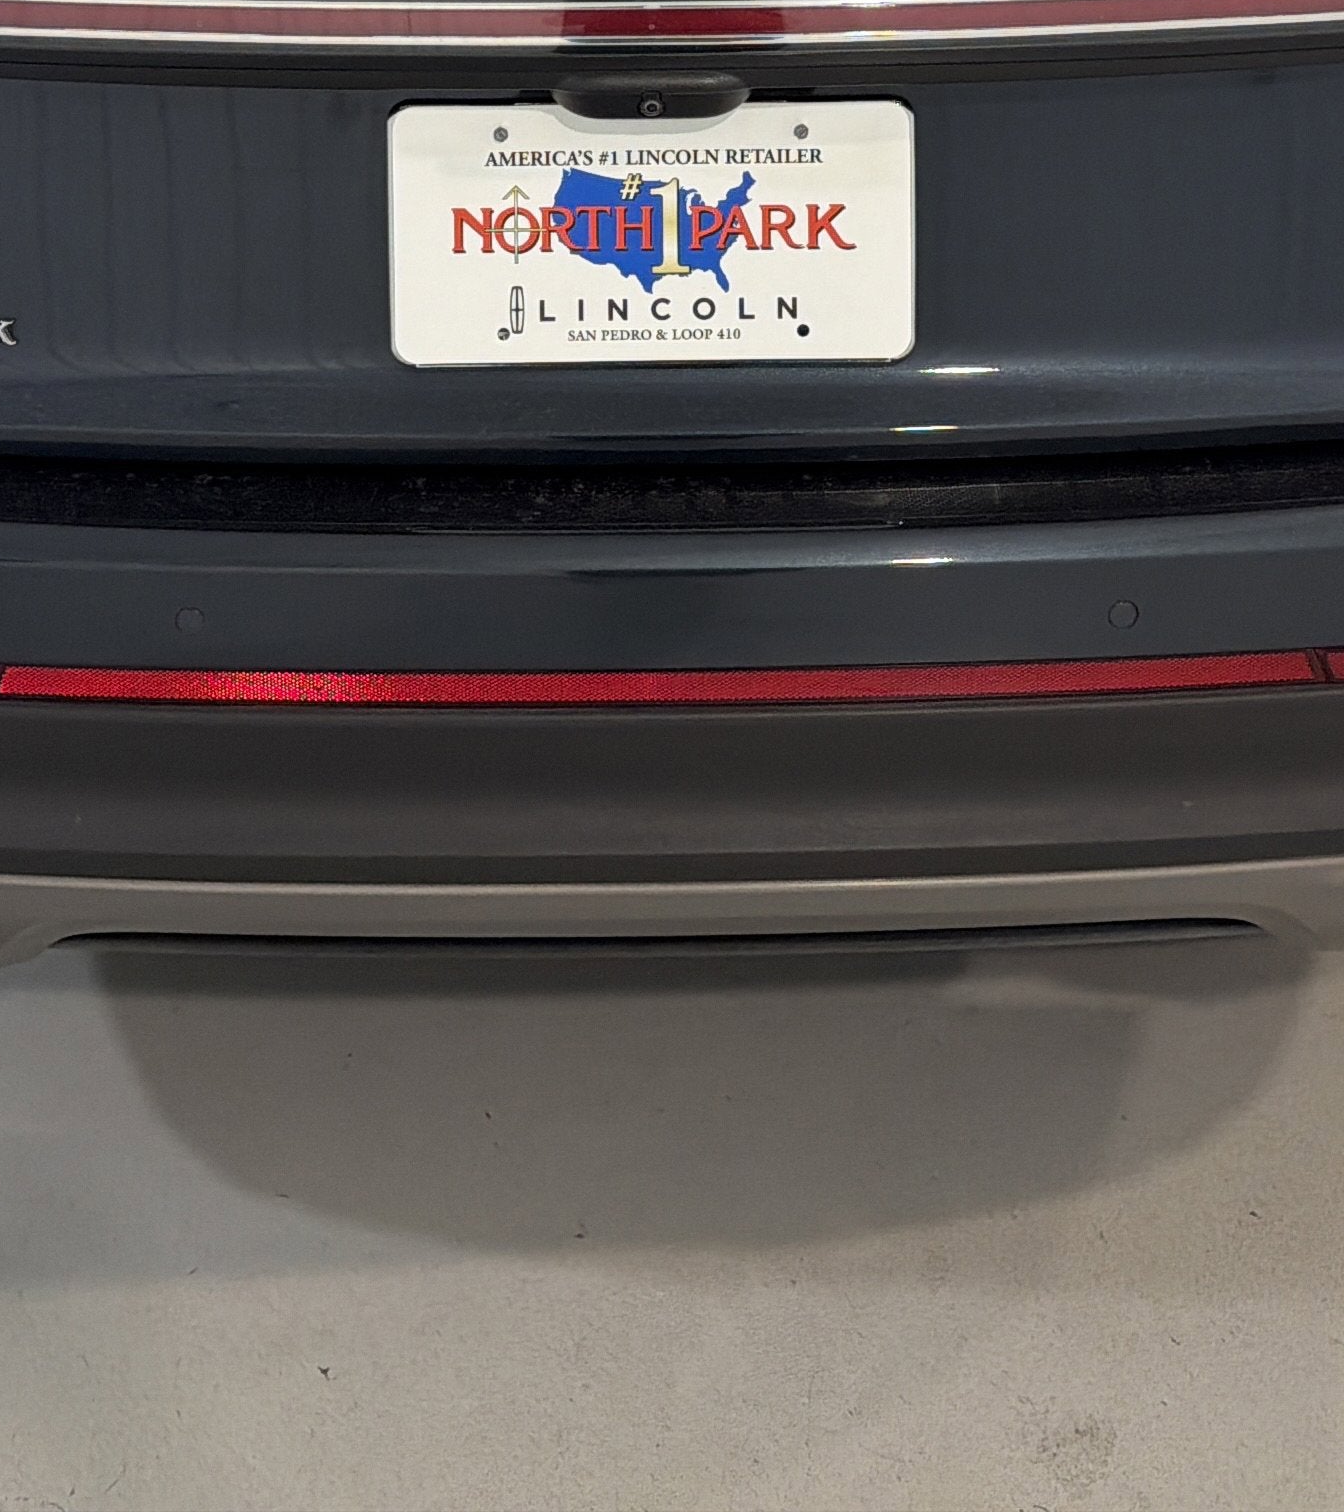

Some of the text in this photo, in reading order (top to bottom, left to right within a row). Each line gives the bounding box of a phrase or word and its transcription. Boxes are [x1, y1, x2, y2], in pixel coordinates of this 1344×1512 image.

[484, 148, 824, 167] AMERICA'S #1 LINCOLN RETAILER
[450, 203, 857, 254] NORTH PARK
[539, 296, 798, 322] LINCOLN
[567, 328, 741, 342] SAN PEDRO & LOOP 410
